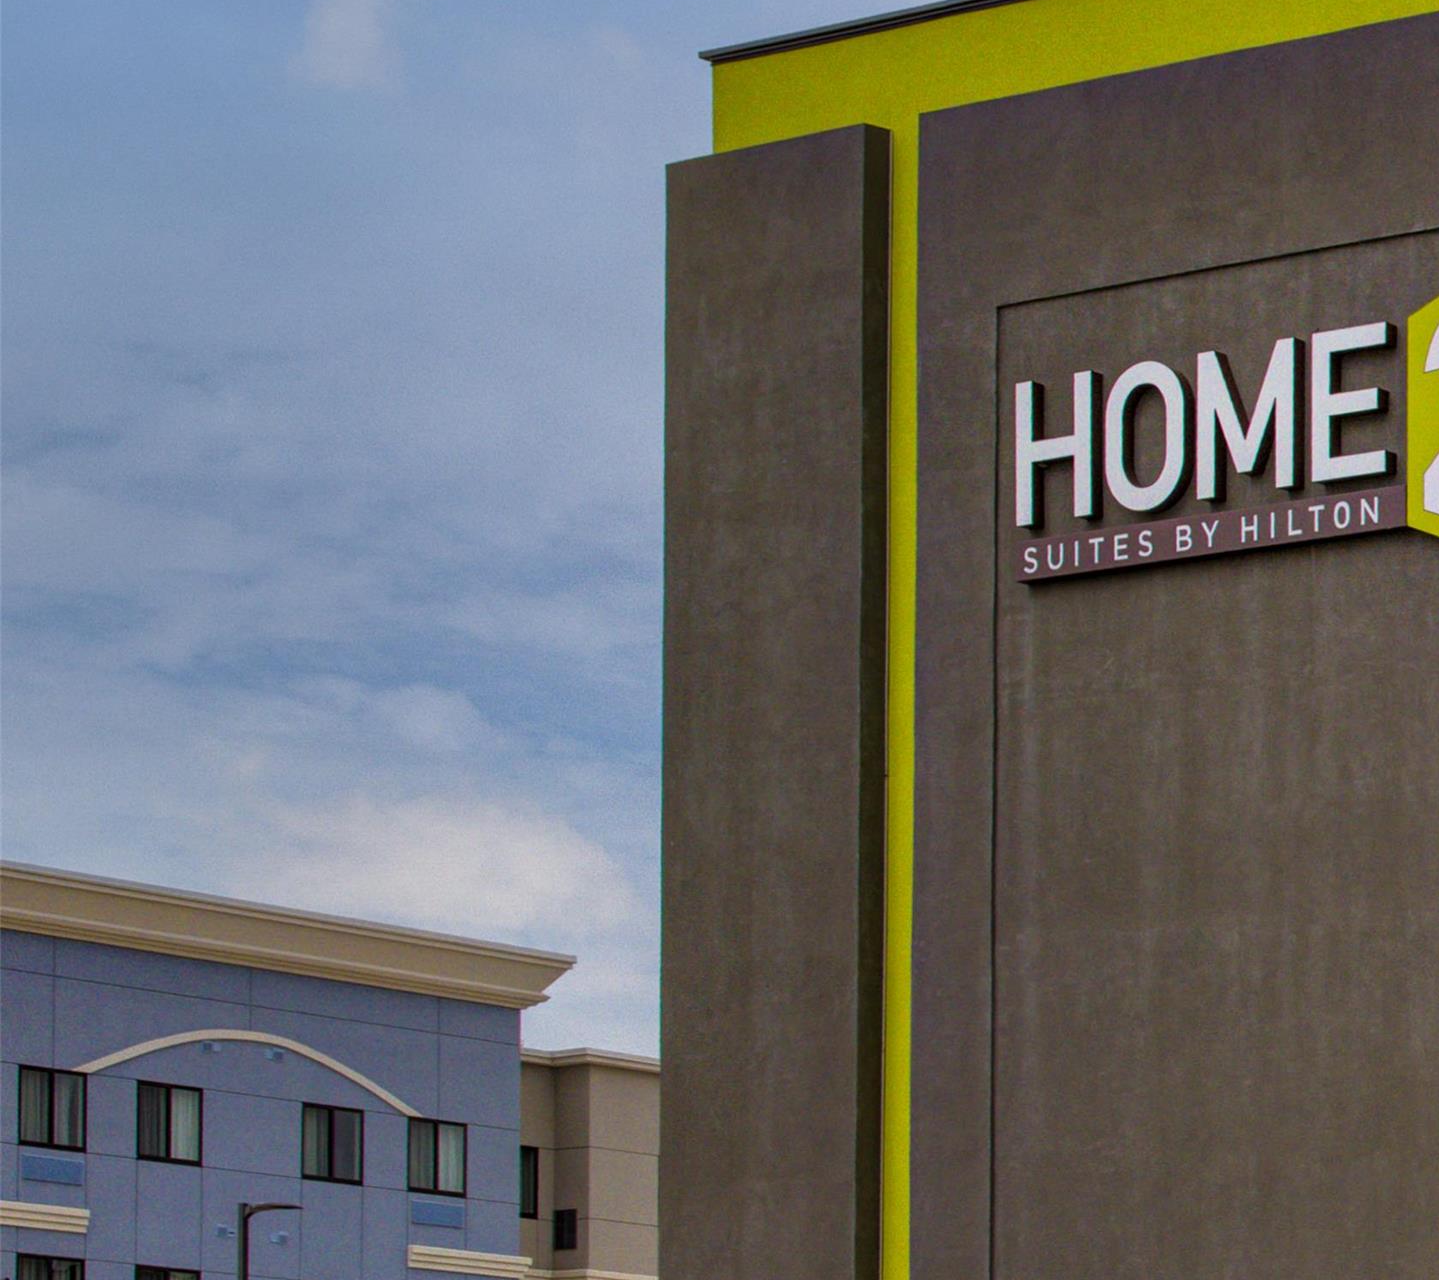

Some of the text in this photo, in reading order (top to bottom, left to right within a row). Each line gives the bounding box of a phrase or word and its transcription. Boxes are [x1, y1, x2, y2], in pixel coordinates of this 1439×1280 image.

[1014, 320, 1394, 529] HOME
[1023, 495, 1380, 574] SUITES BY HILTON
